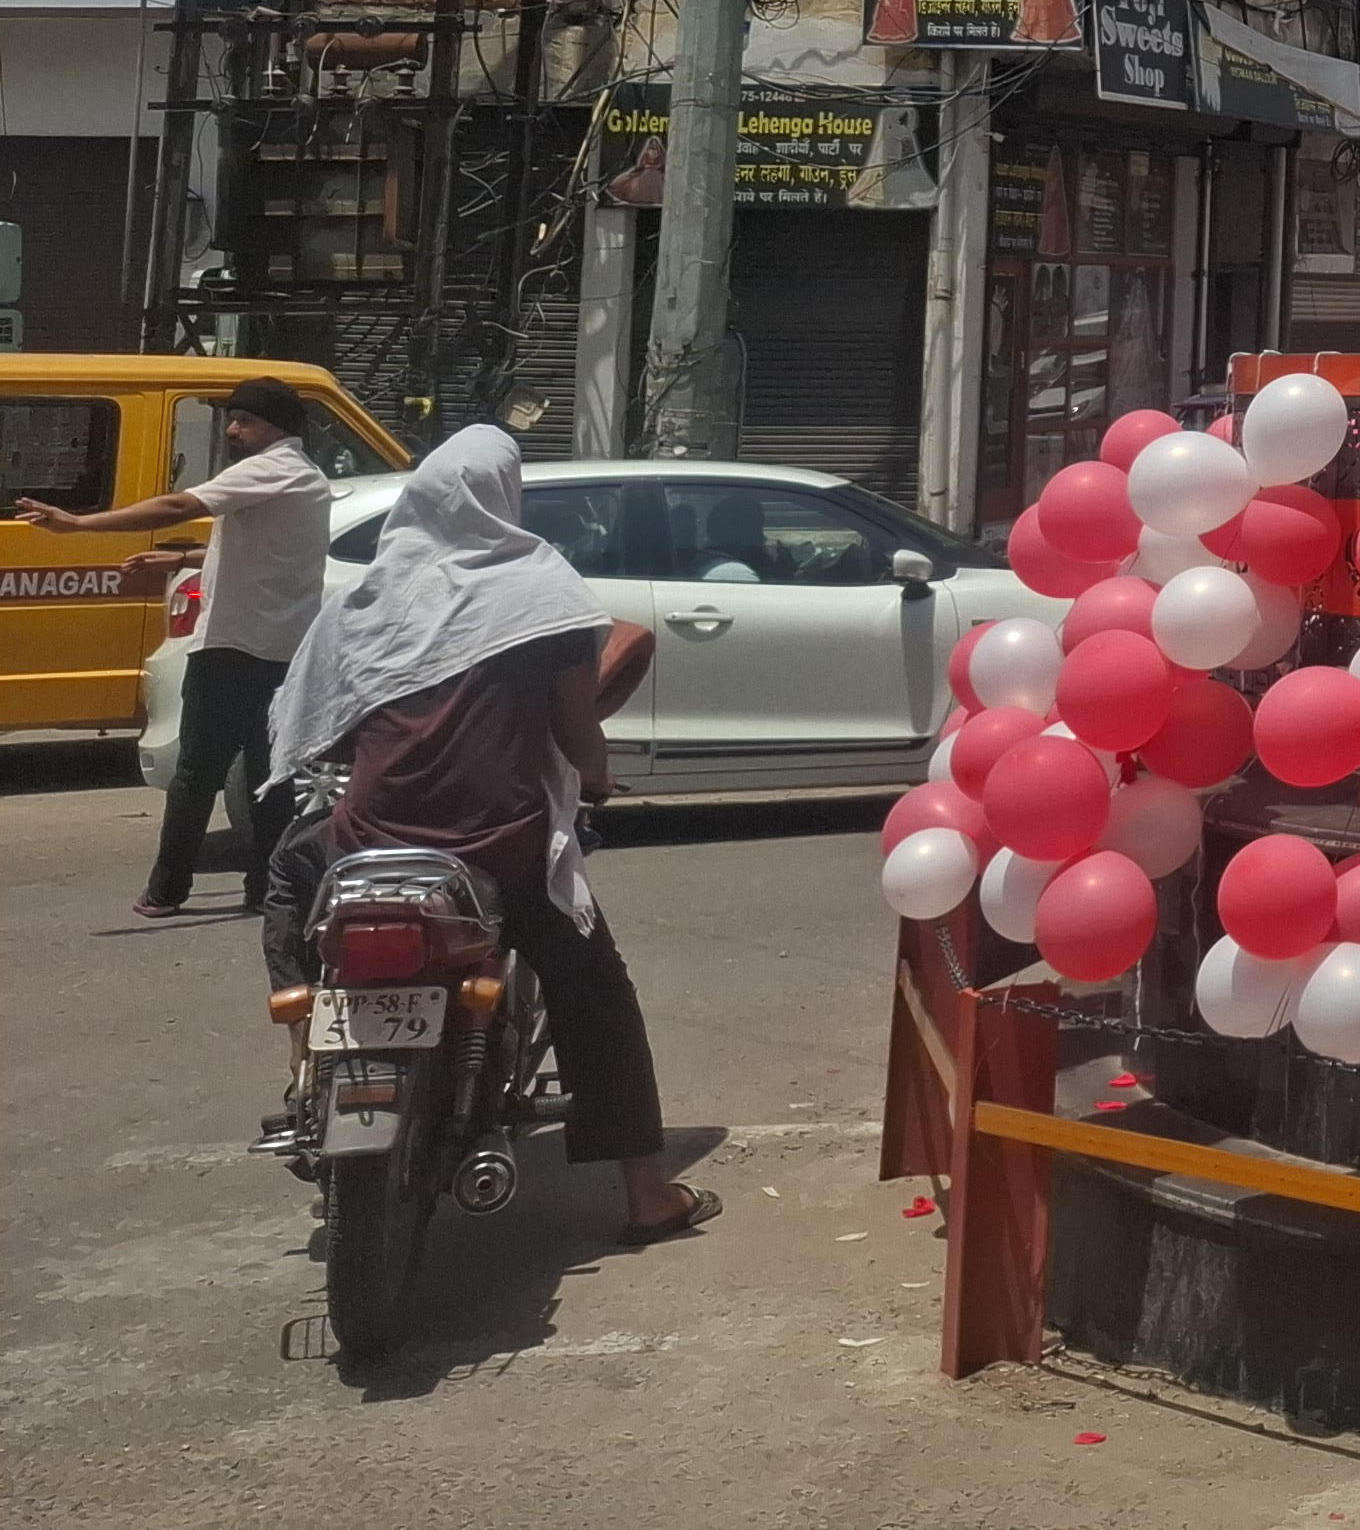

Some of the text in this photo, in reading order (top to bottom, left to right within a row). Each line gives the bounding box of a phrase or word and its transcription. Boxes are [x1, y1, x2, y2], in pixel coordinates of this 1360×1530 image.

[1101, 5, 1184, 57] Sweets
[1124, 53, 1165, 97] Shop
[738, 111, 813, 138] Lehenga
[819, 112, 873, 135] House
